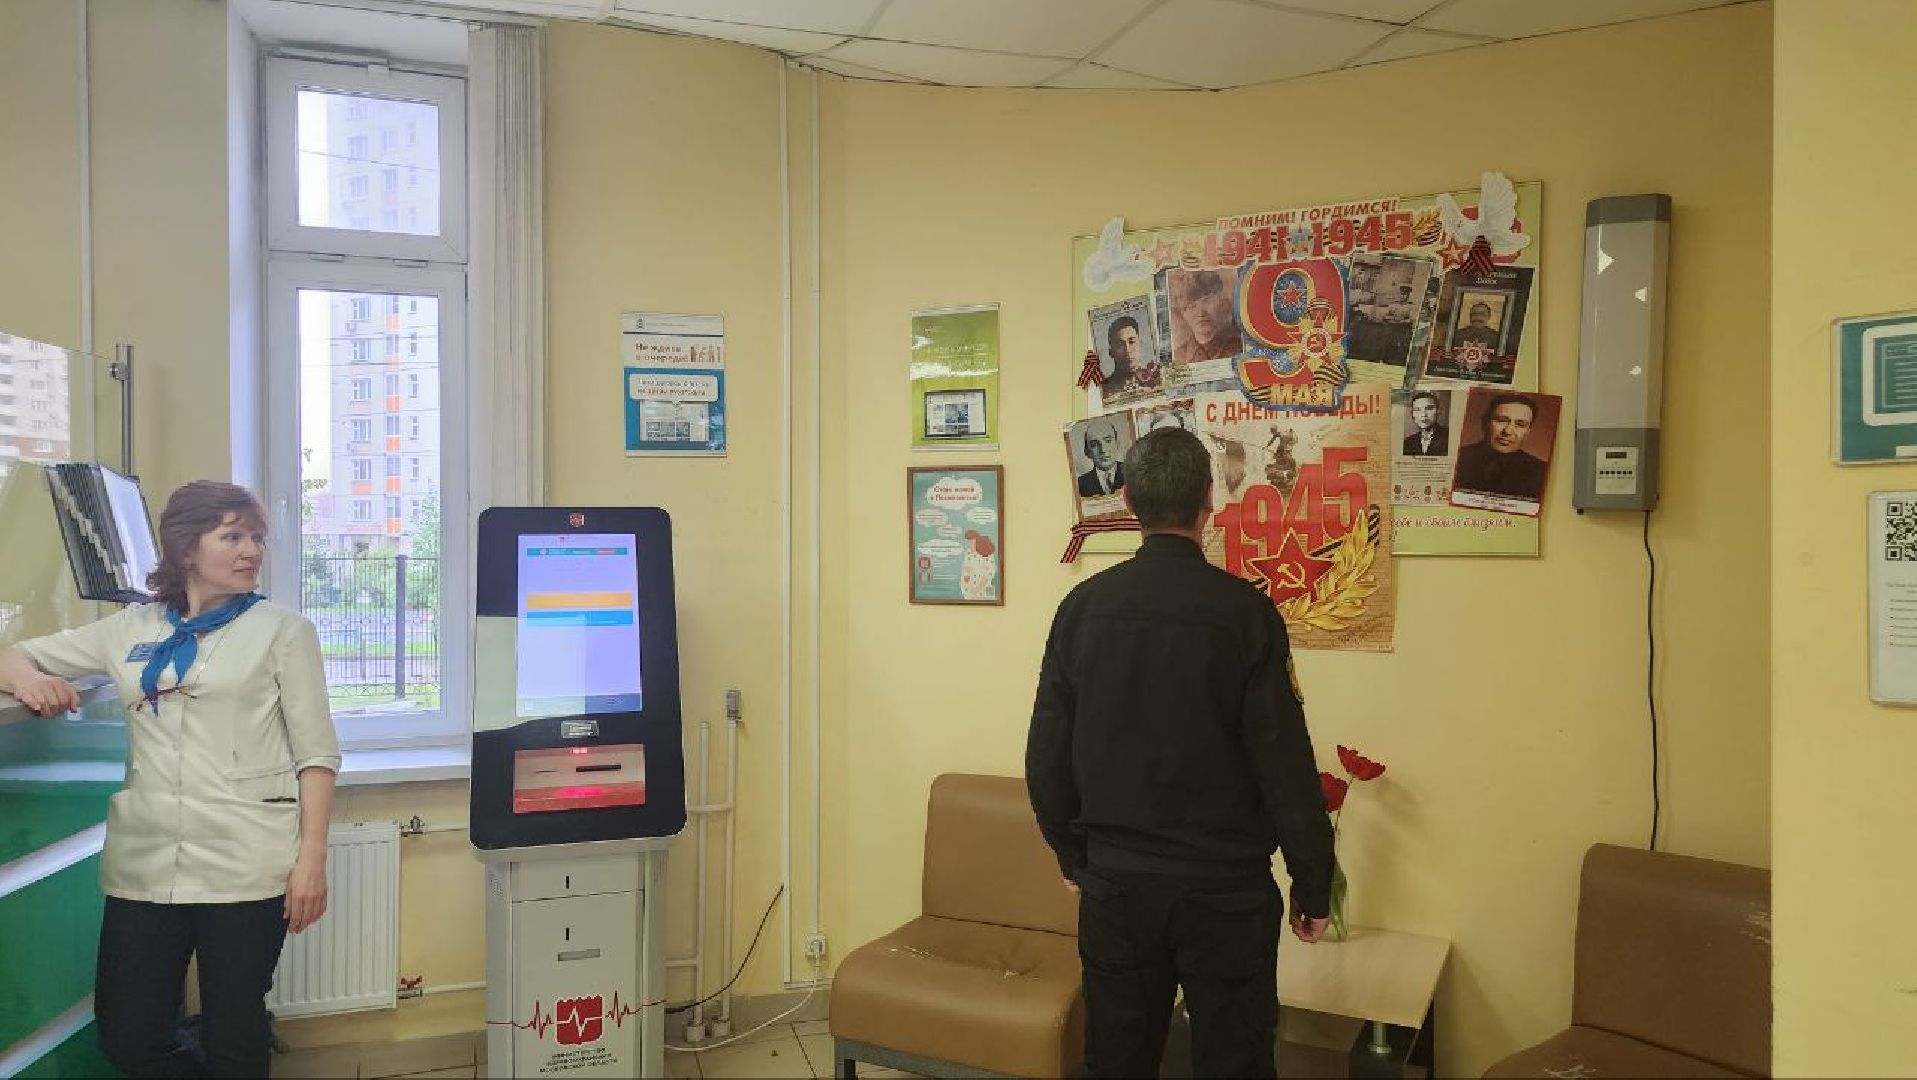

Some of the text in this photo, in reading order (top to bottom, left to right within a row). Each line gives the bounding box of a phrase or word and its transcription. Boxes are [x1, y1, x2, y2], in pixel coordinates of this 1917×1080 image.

[1218, 199, 1398, 231] ПОМНИМ! ГОРДИМСЯ!
[1311, 212, 1414, 257] 1945
[1203, 225, 1291, 267] 1941
[1238, 258, 1347, 389] 9
[1206, 403, 1218, 423] С
[1270, 383, 1335, 406] МАЯ
[1213, 446, 1369, 577] 1945
